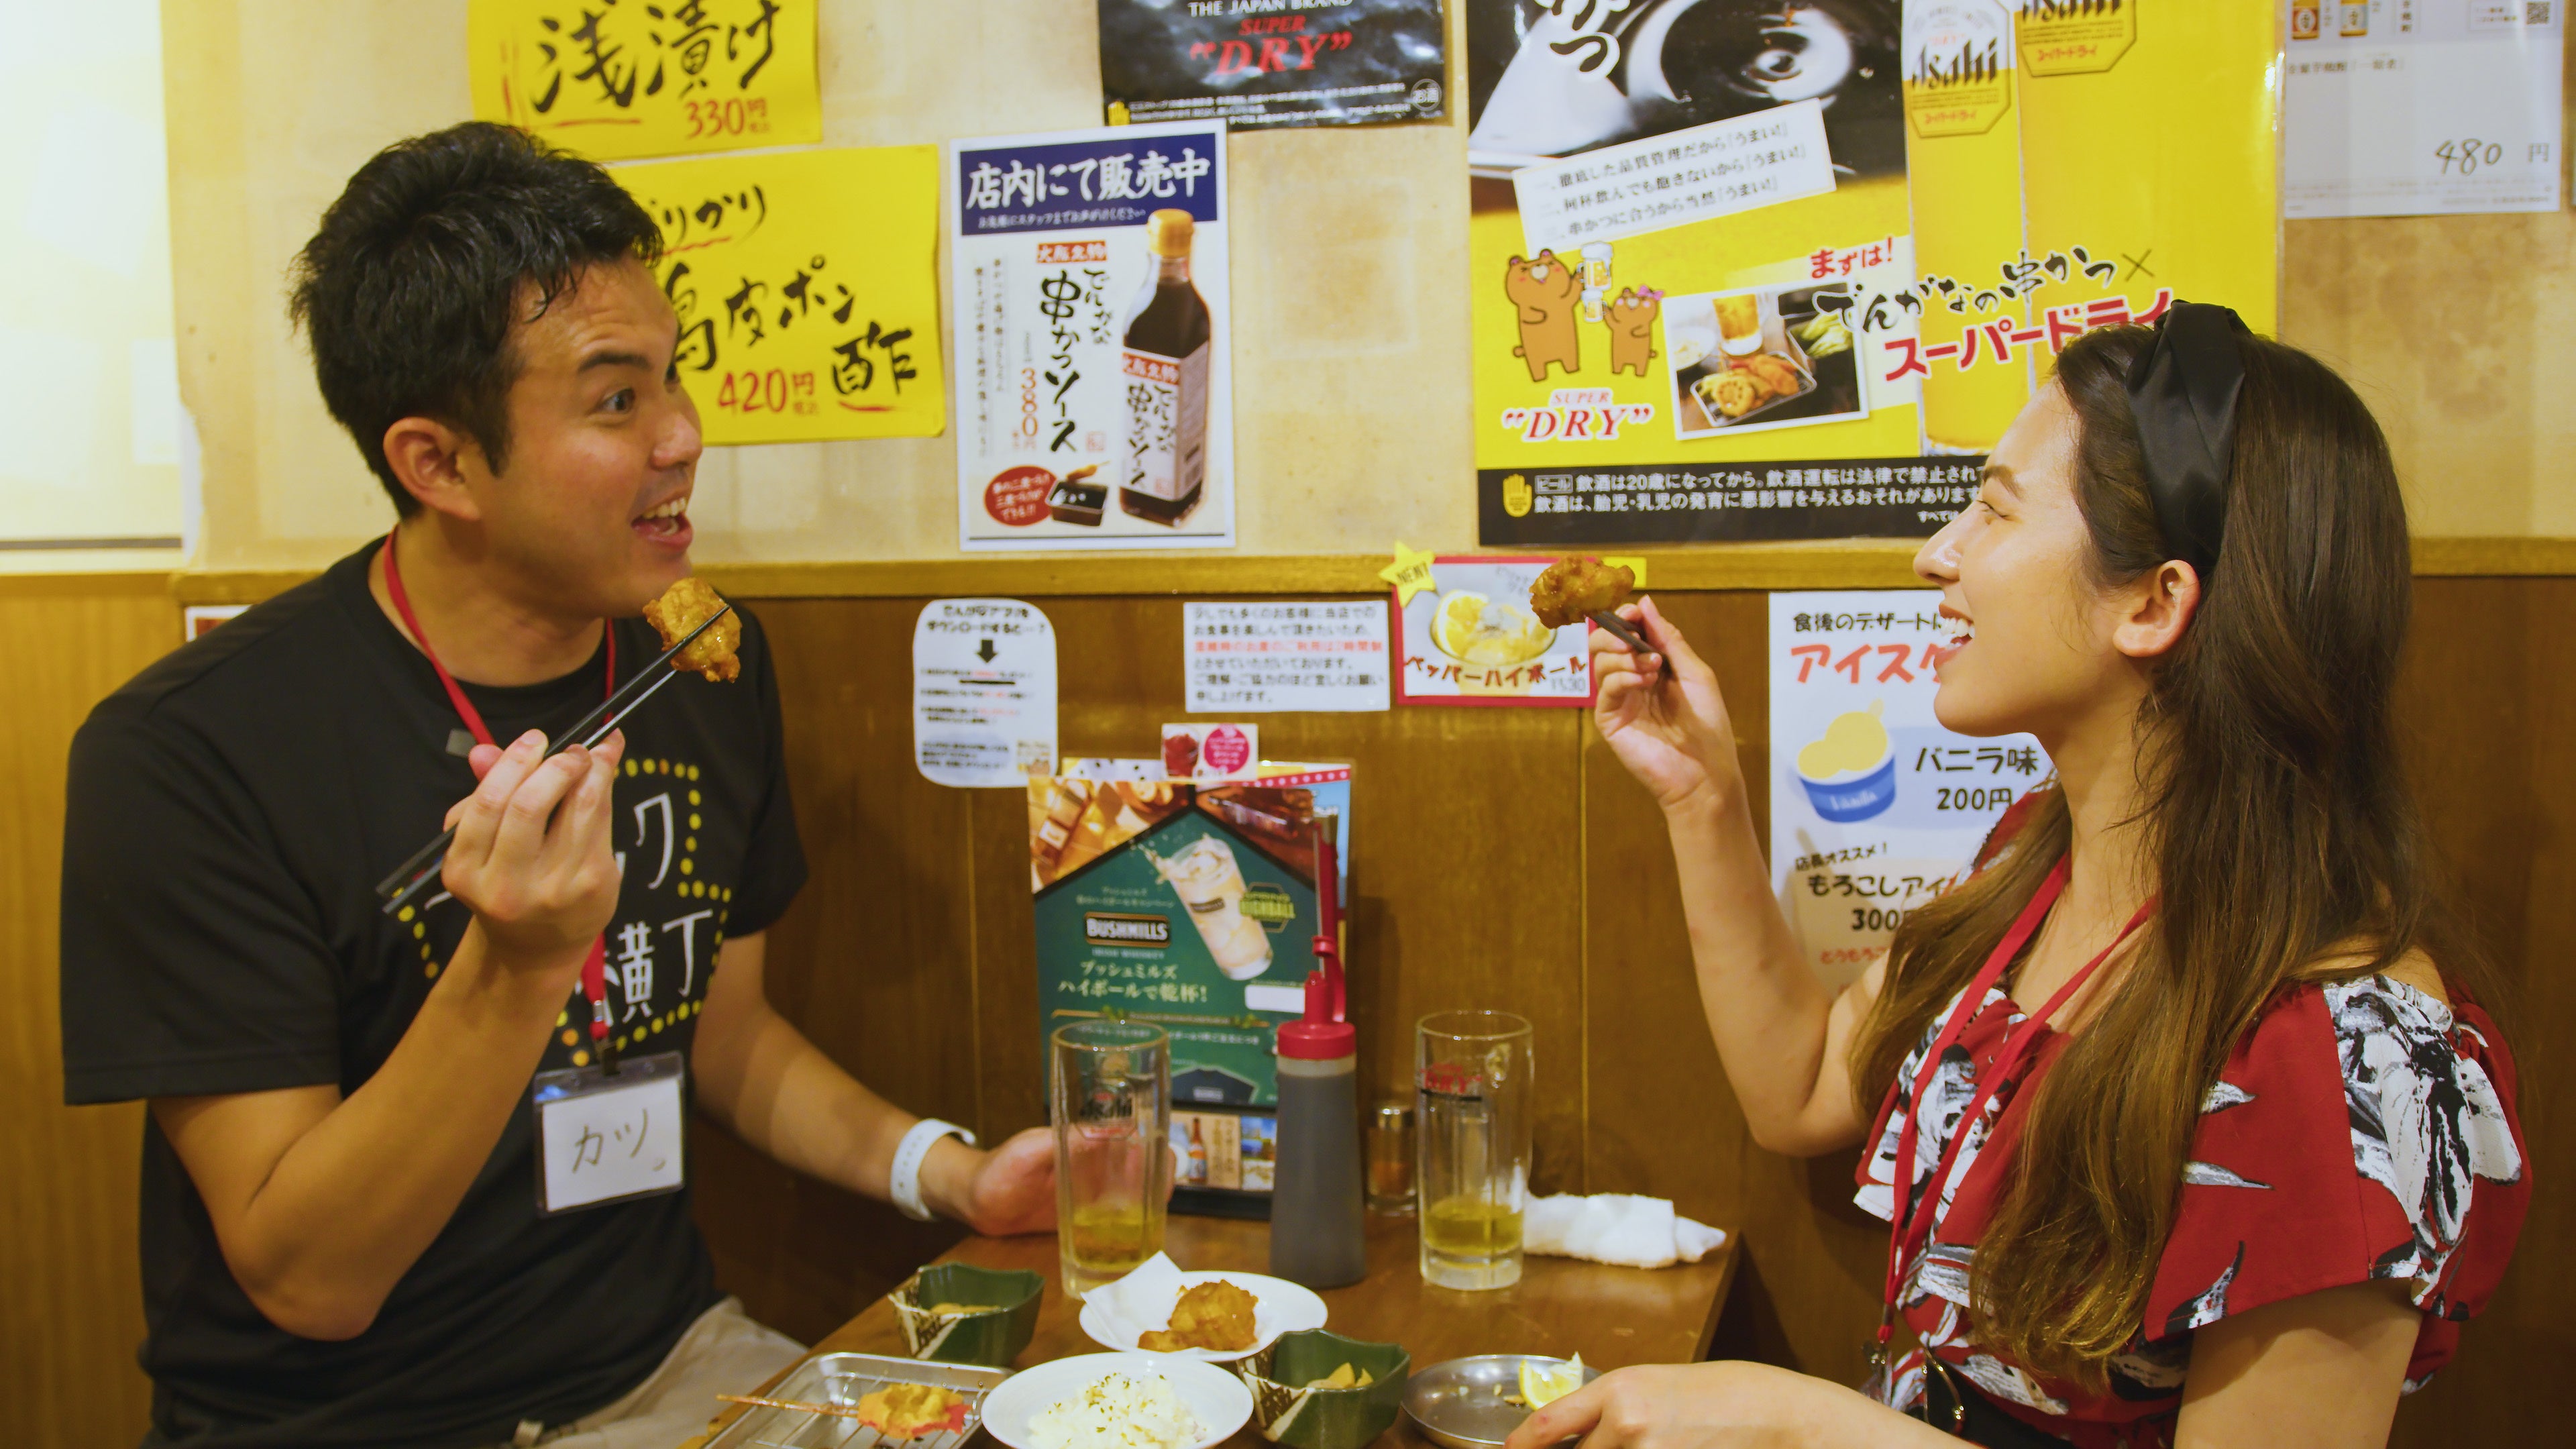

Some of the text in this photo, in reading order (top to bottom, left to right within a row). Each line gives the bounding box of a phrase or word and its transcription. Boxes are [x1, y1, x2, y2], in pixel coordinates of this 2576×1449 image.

[1188, 1, 1223, 17] THE
[1228, 0, 1286, 15] JAPAN
[1238, 15, 1306, 35] SUPER
[533, 0, 780, 113] 浅漬け
[1911, 37, 1998, 89] Asahi
[685, 97, 767, 138] 330円
[2434, 138, 2549, 176] 480 円
[966, 147, 1210, 209] 店内にて販売中
[649, 185, 766, 247] りかり
[1811, 236, 1894, 278] まずは!
[1040, 269, 1081, 453] 串かつソース
[718, 369, 814, 413] 420円
[1554, 391, 1609, 404] SUPER
[1397, 564, 1429, 585] NEW!
[1915, 746, 2039, 776] バニラ味
[1937, 788, 2012, 810] 200円
[1087, 918, 1169, 941] BUSHMILLS
[1080, 959, 1179, 980] ブッシュミルズ
[1057, 978, 1208, 1003] ハイボールで乾杯!
